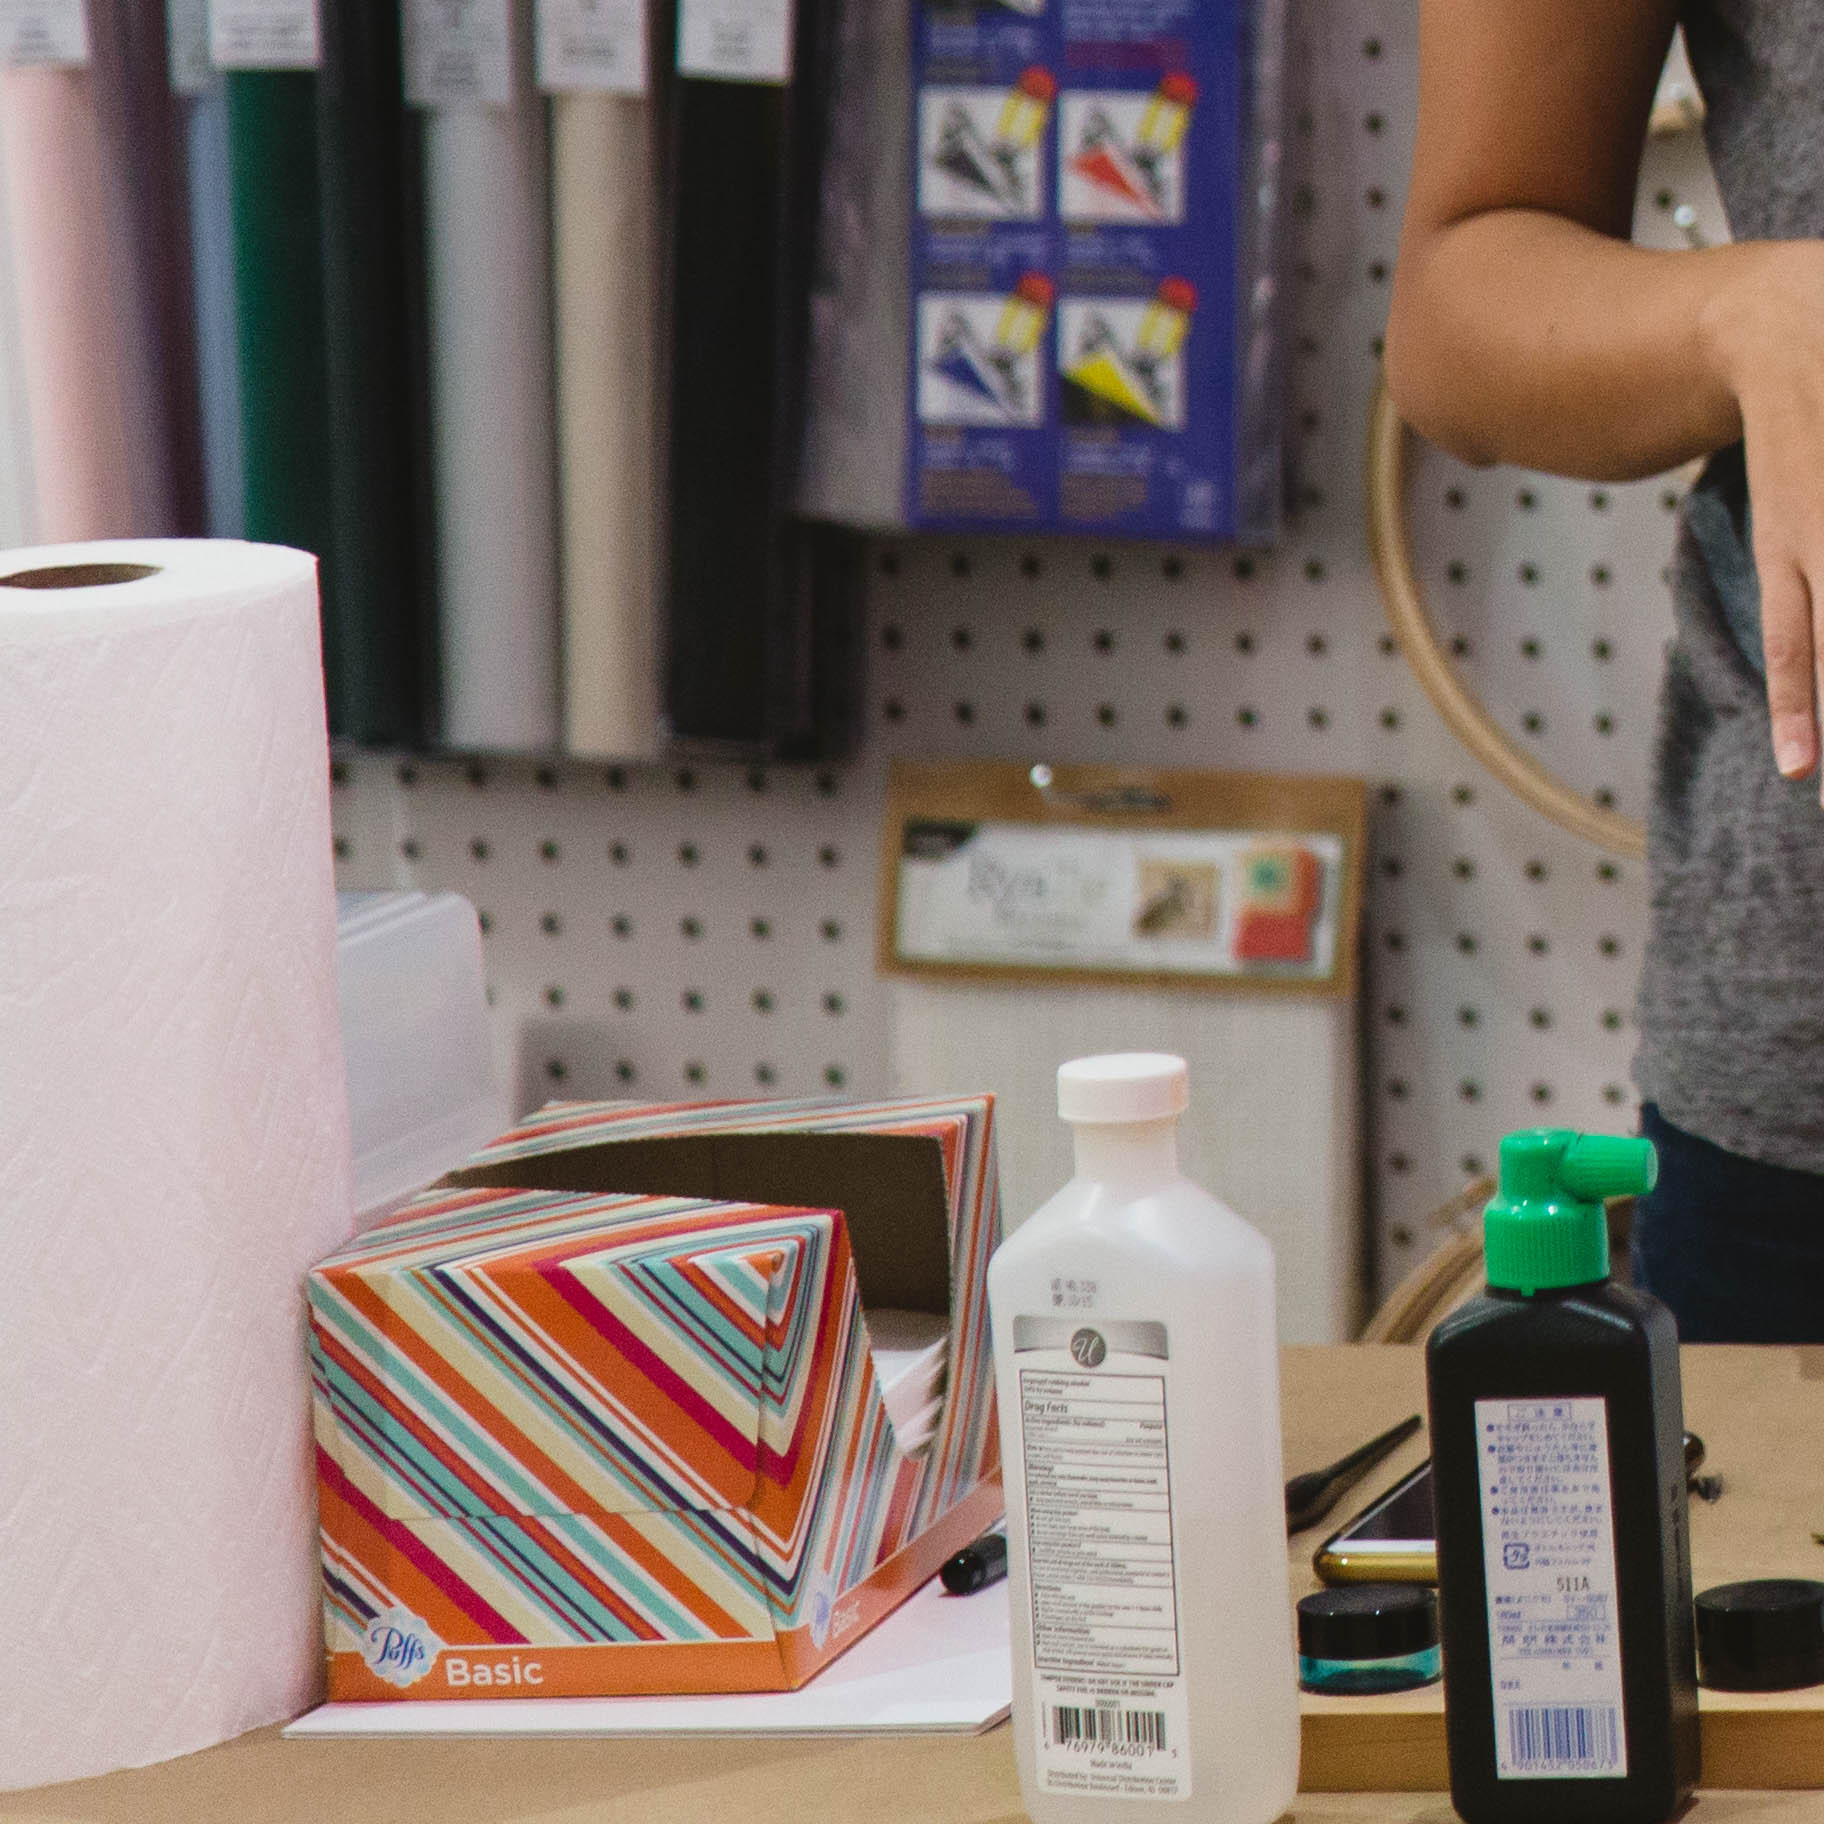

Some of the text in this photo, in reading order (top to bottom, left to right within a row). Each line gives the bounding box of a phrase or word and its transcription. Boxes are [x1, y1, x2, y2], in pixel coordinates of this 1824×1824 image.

[1025, 1399, 1069, 1415] Drug Facts
[1556, 1576, 1590, 1592] 511A
[370, 1624, 426, 1666] Puffs
[444, 1657, 544, 1688] Basic
